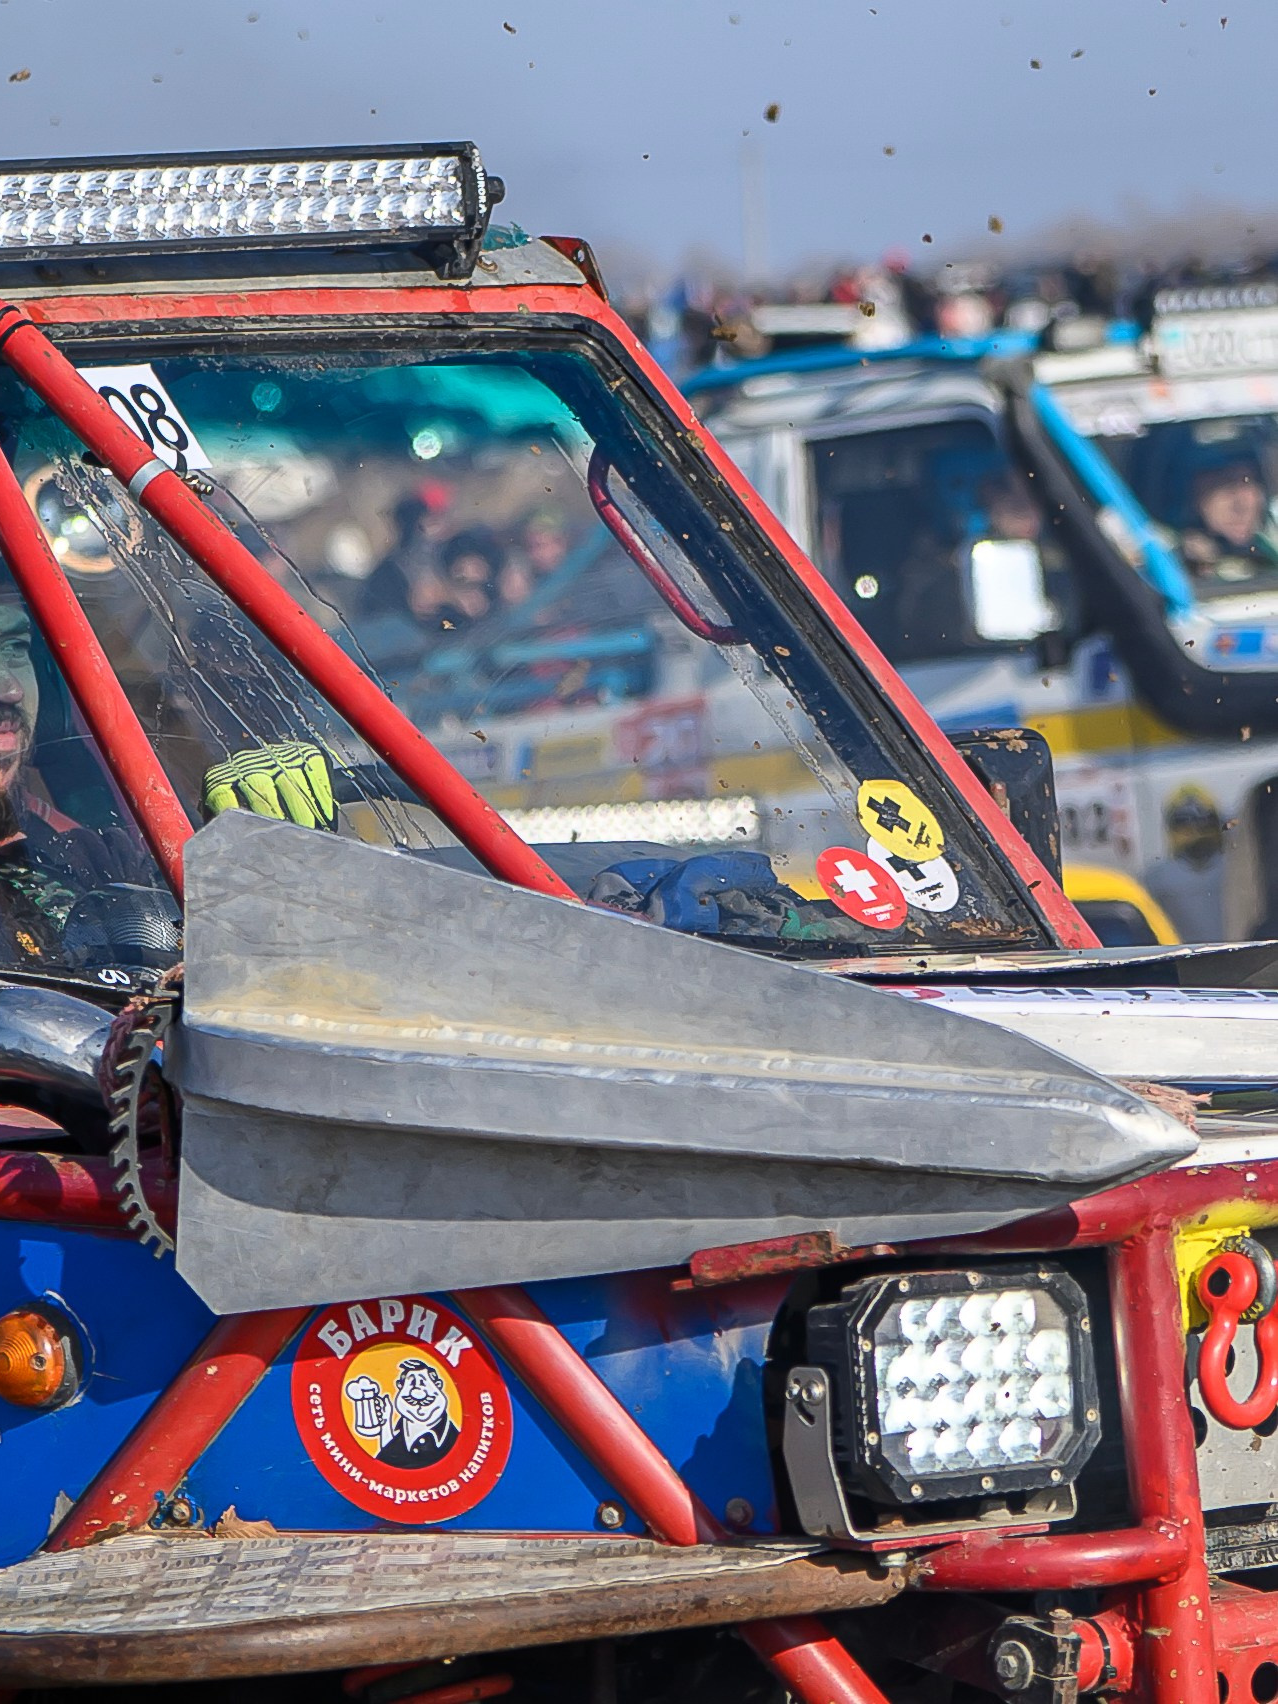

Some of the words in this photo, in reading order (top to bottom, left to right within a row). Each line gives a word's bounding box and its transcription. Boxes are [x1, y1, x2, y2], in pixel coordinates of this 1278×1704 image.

[97, 383, 189, 452] 08
[317, 1299, 473, 1369] БАРИК
[308, 1383, 326, 1429] сеть
[320, 1432, 461, 1504] мини-маркетов
[458, 1391, 495, 1484] напитков
